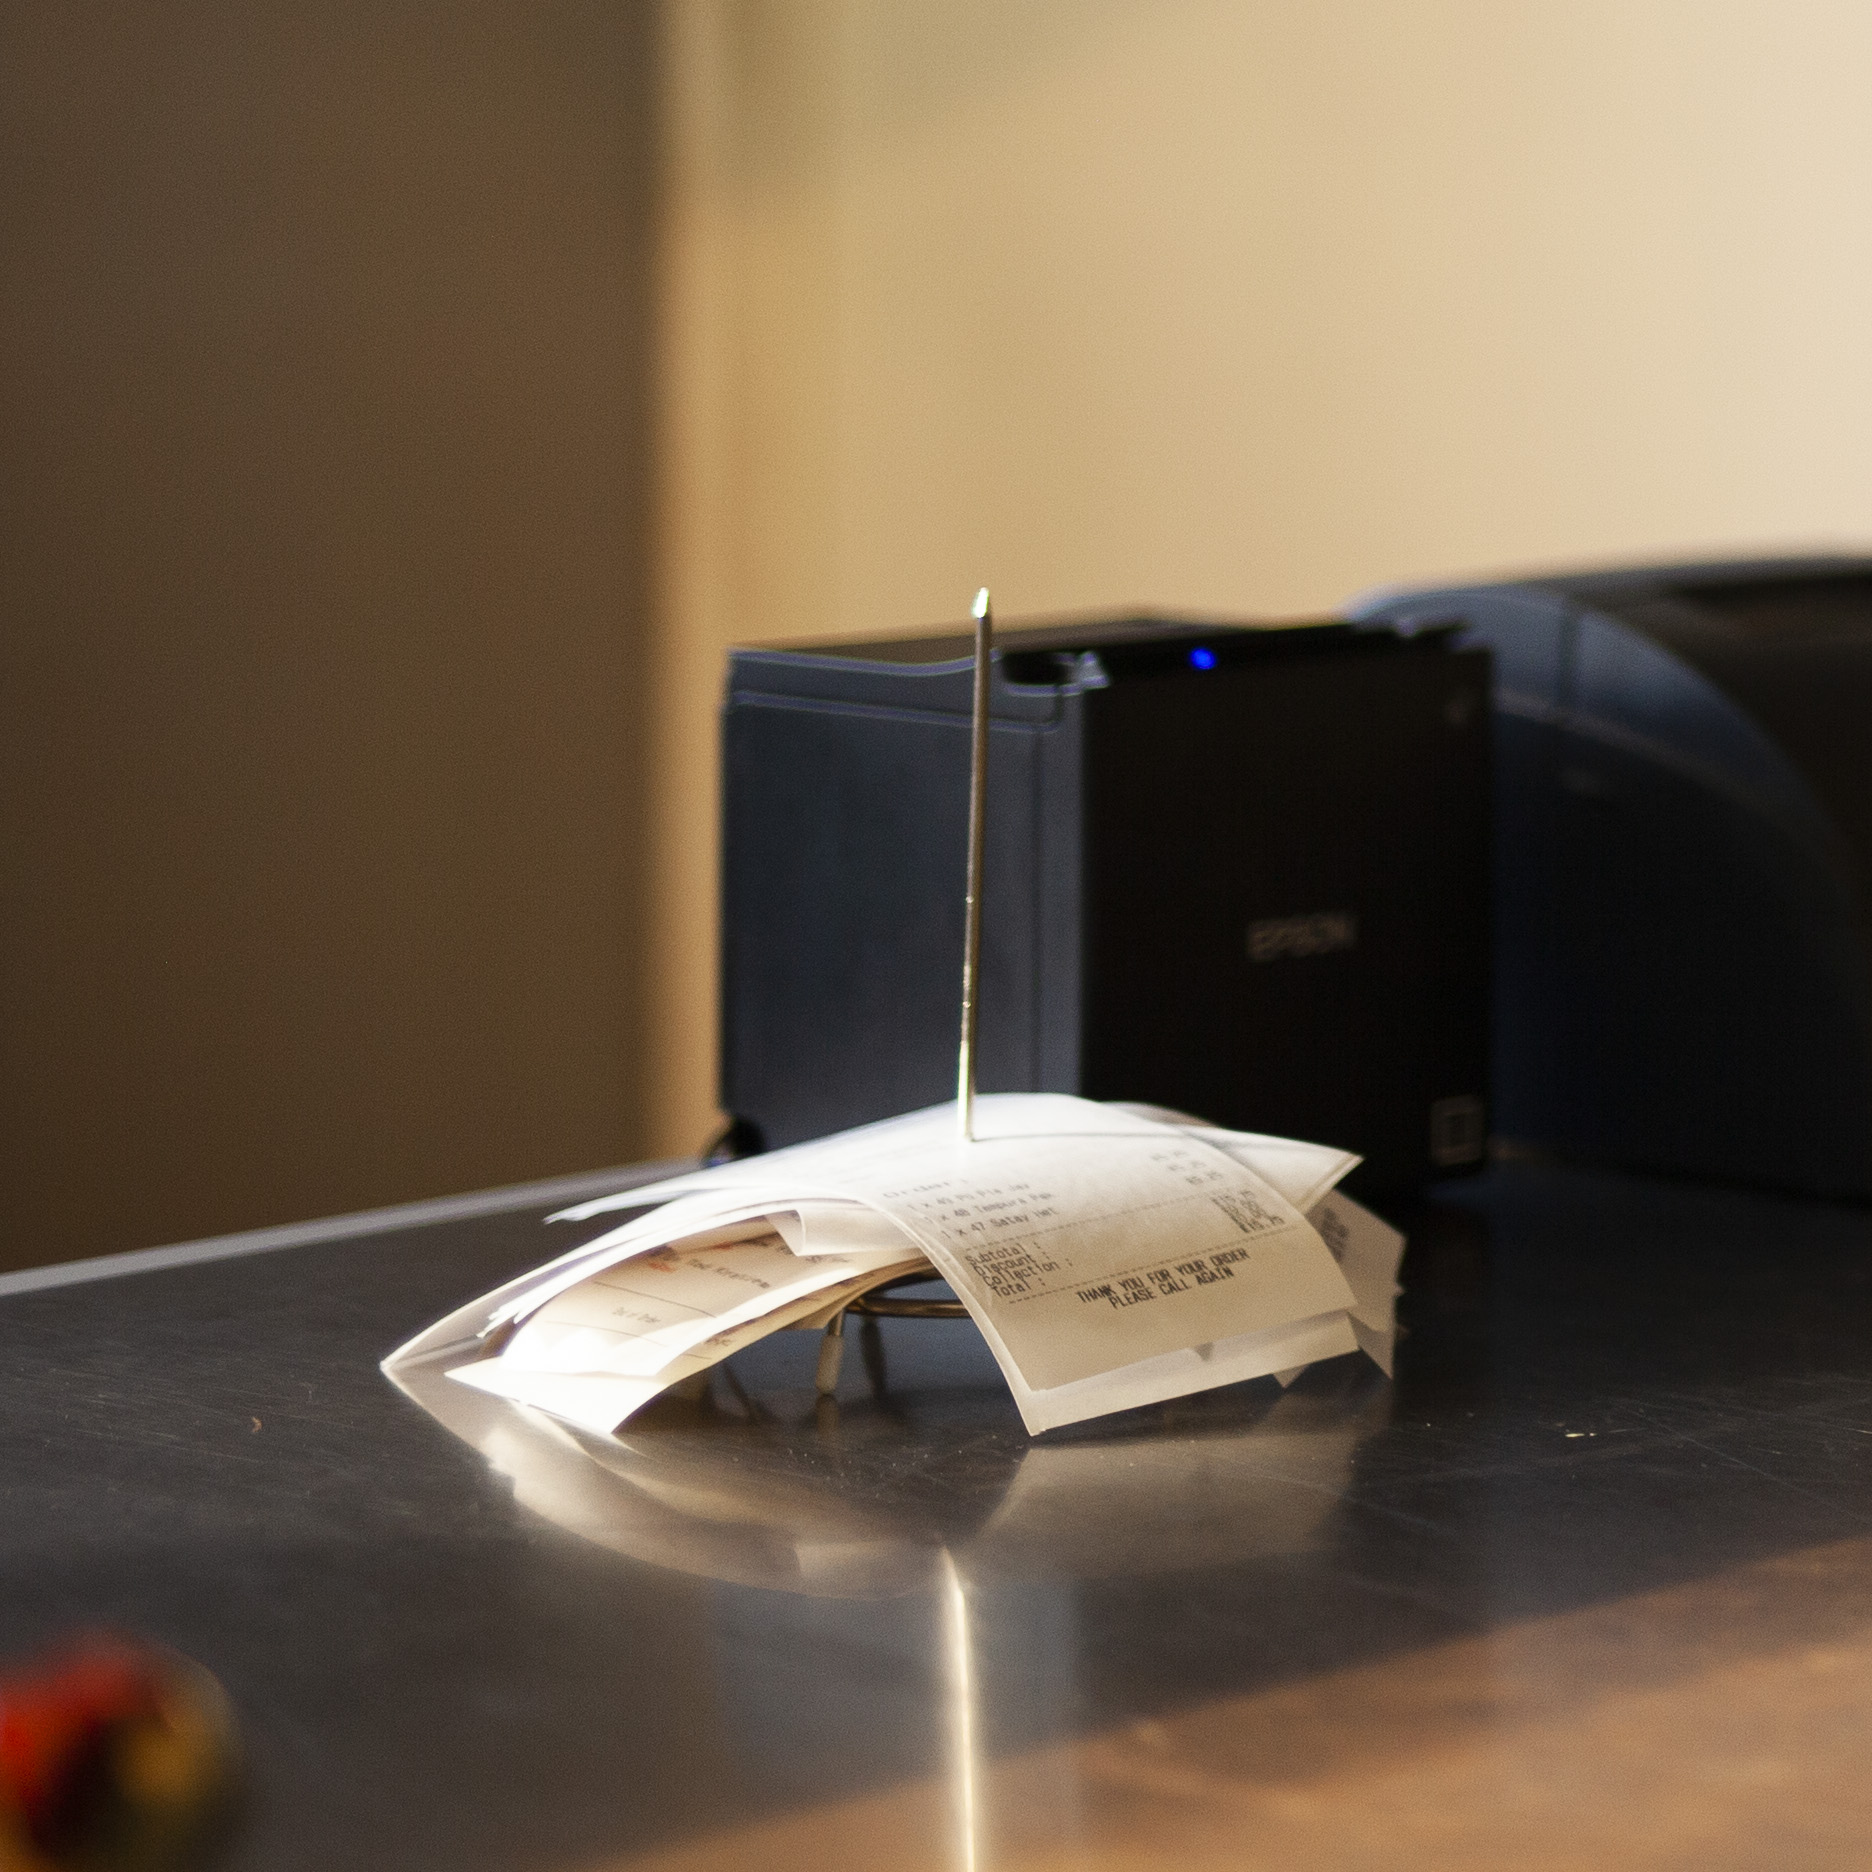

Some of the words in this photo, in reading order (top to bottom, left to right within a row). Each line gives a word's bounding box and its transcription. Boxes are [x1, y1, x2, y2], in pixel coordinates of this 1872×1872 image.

[989, 1213, 1030, 1229] Satay
[965, 1242, 1027, 1267] Subtotal
[973, 1253, 1037, 1278] Discount
[983, 1260, 1061, 1289] Collection
[1076, 1284, 1117, 1304] THANK
[1118, 1276, 1145, 1293] YOU
[1146, 1269, 1171, 1285] FOR
[1174, 1260, 1207, 1277] YOUR
[1209, 1248, 1250, 1268] ORDER
[992, 1279, 1032, 1299] Total
[1108, 1289, 1156, 1310] PLEASE
[1158, 1279, 1192, 1296] CALL
[1195, 1266, 1235, 1286] AGAIN
